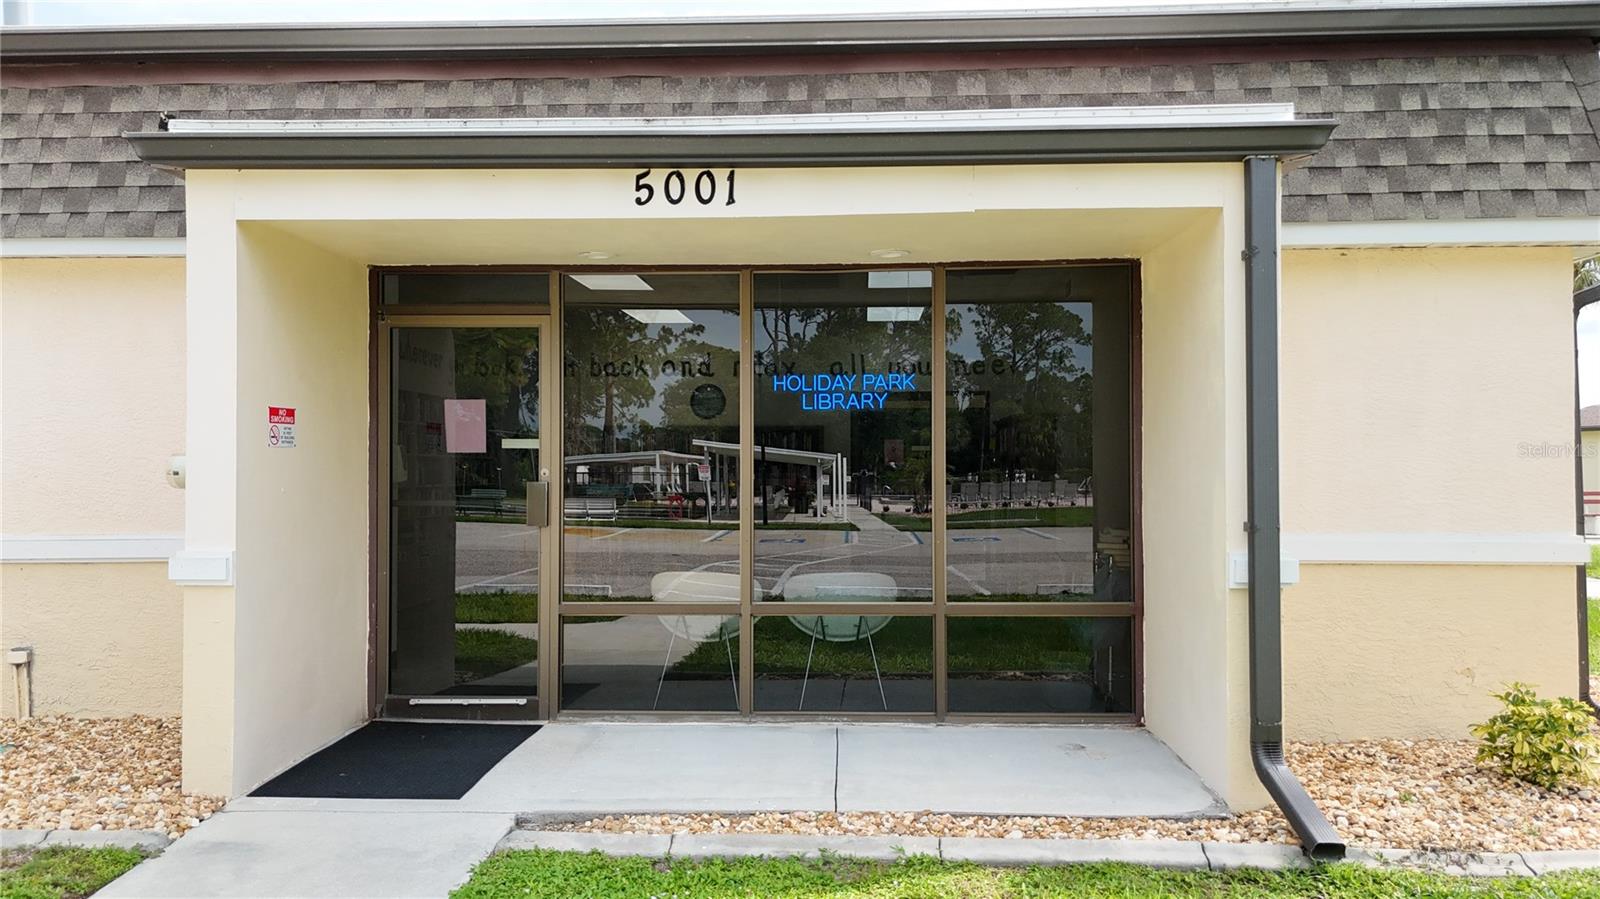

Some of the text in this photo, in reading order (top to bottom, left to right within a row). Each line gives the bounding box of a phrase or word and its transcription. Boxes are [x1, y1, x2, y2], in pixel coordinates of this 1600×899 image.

[634, 168, 737, 206] 5001
[589, 352, 650, 378] back
[661, 351, 715, 378] and
[829, 353, 866, 376] all
[773, 373, 916, 392] HOLIDAY PARK
[802, 392, 888, 410] LIBRARY
[270, 415, 294, 424] SMOKING
